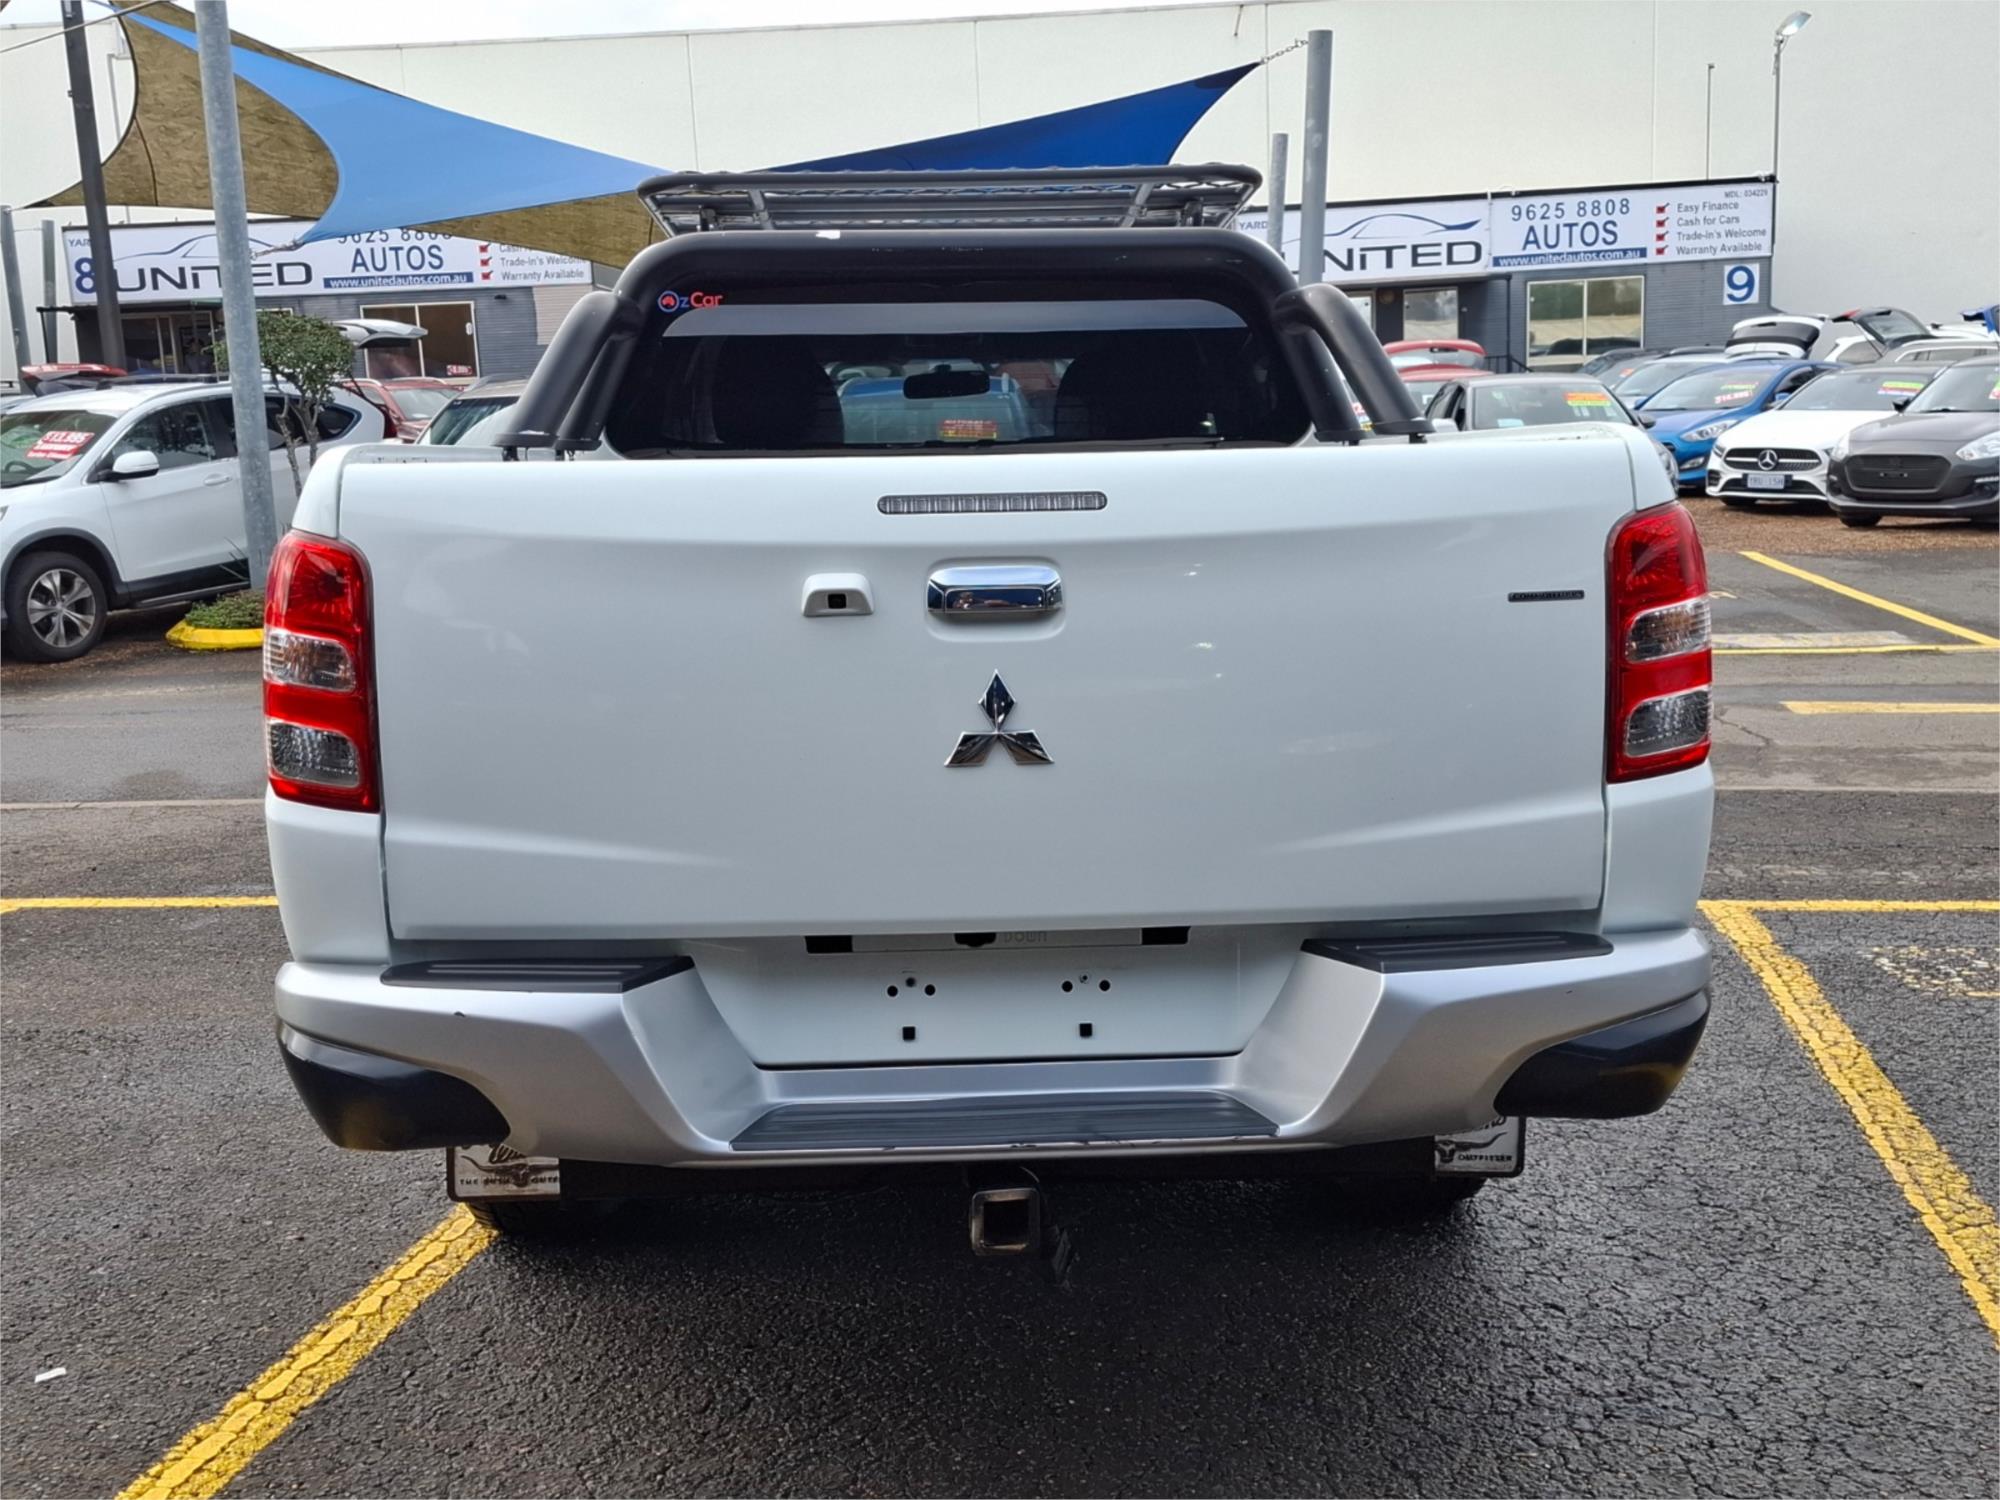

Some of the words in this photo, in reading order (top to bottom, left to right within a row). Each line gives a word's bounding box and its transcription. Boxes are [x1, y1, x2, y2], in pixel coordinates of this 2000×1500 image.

[1511, 202, 1565, 222] 9625
[1576, 198, 1631, 218] 8808
[1676, 203, 1700, 214] Easy
[1702, 201, 1740, 212] Finance
[1239, 220, 1268, 230] YARD
[1676, 217, 1700, 227] Cash
[1703, 216, 1717, 226] for
[1719, 215, 1741, 225] Cars
[1522, 220, 1619, 251] AUTOS
[1676, 230, 1722, 241] Trade-in's
[1724, 228, 1767, 239] Welcome
[68, 238, 92, 248] YAR
[1676, 245, 1718, 256] Warranty
[1720, 242, 1763, 252] Available
[350, 244, 444, 273] AUTOS
[1281, 241, 1482, 274] NITED
[1498, 249, 1641, 267] www.unitedautos.com.au
[74, 257, 97, 294] 8
[329, 273, 467, 289] www.unitedautos.com.au
[501, 271, 541, 281] Warranty
[543, 268, 584, 279] Available
[1725, 265, 1756, 302] 9
[658, 290, 723, 313] OzCar
[460, 1177, 479, 1185] THE
